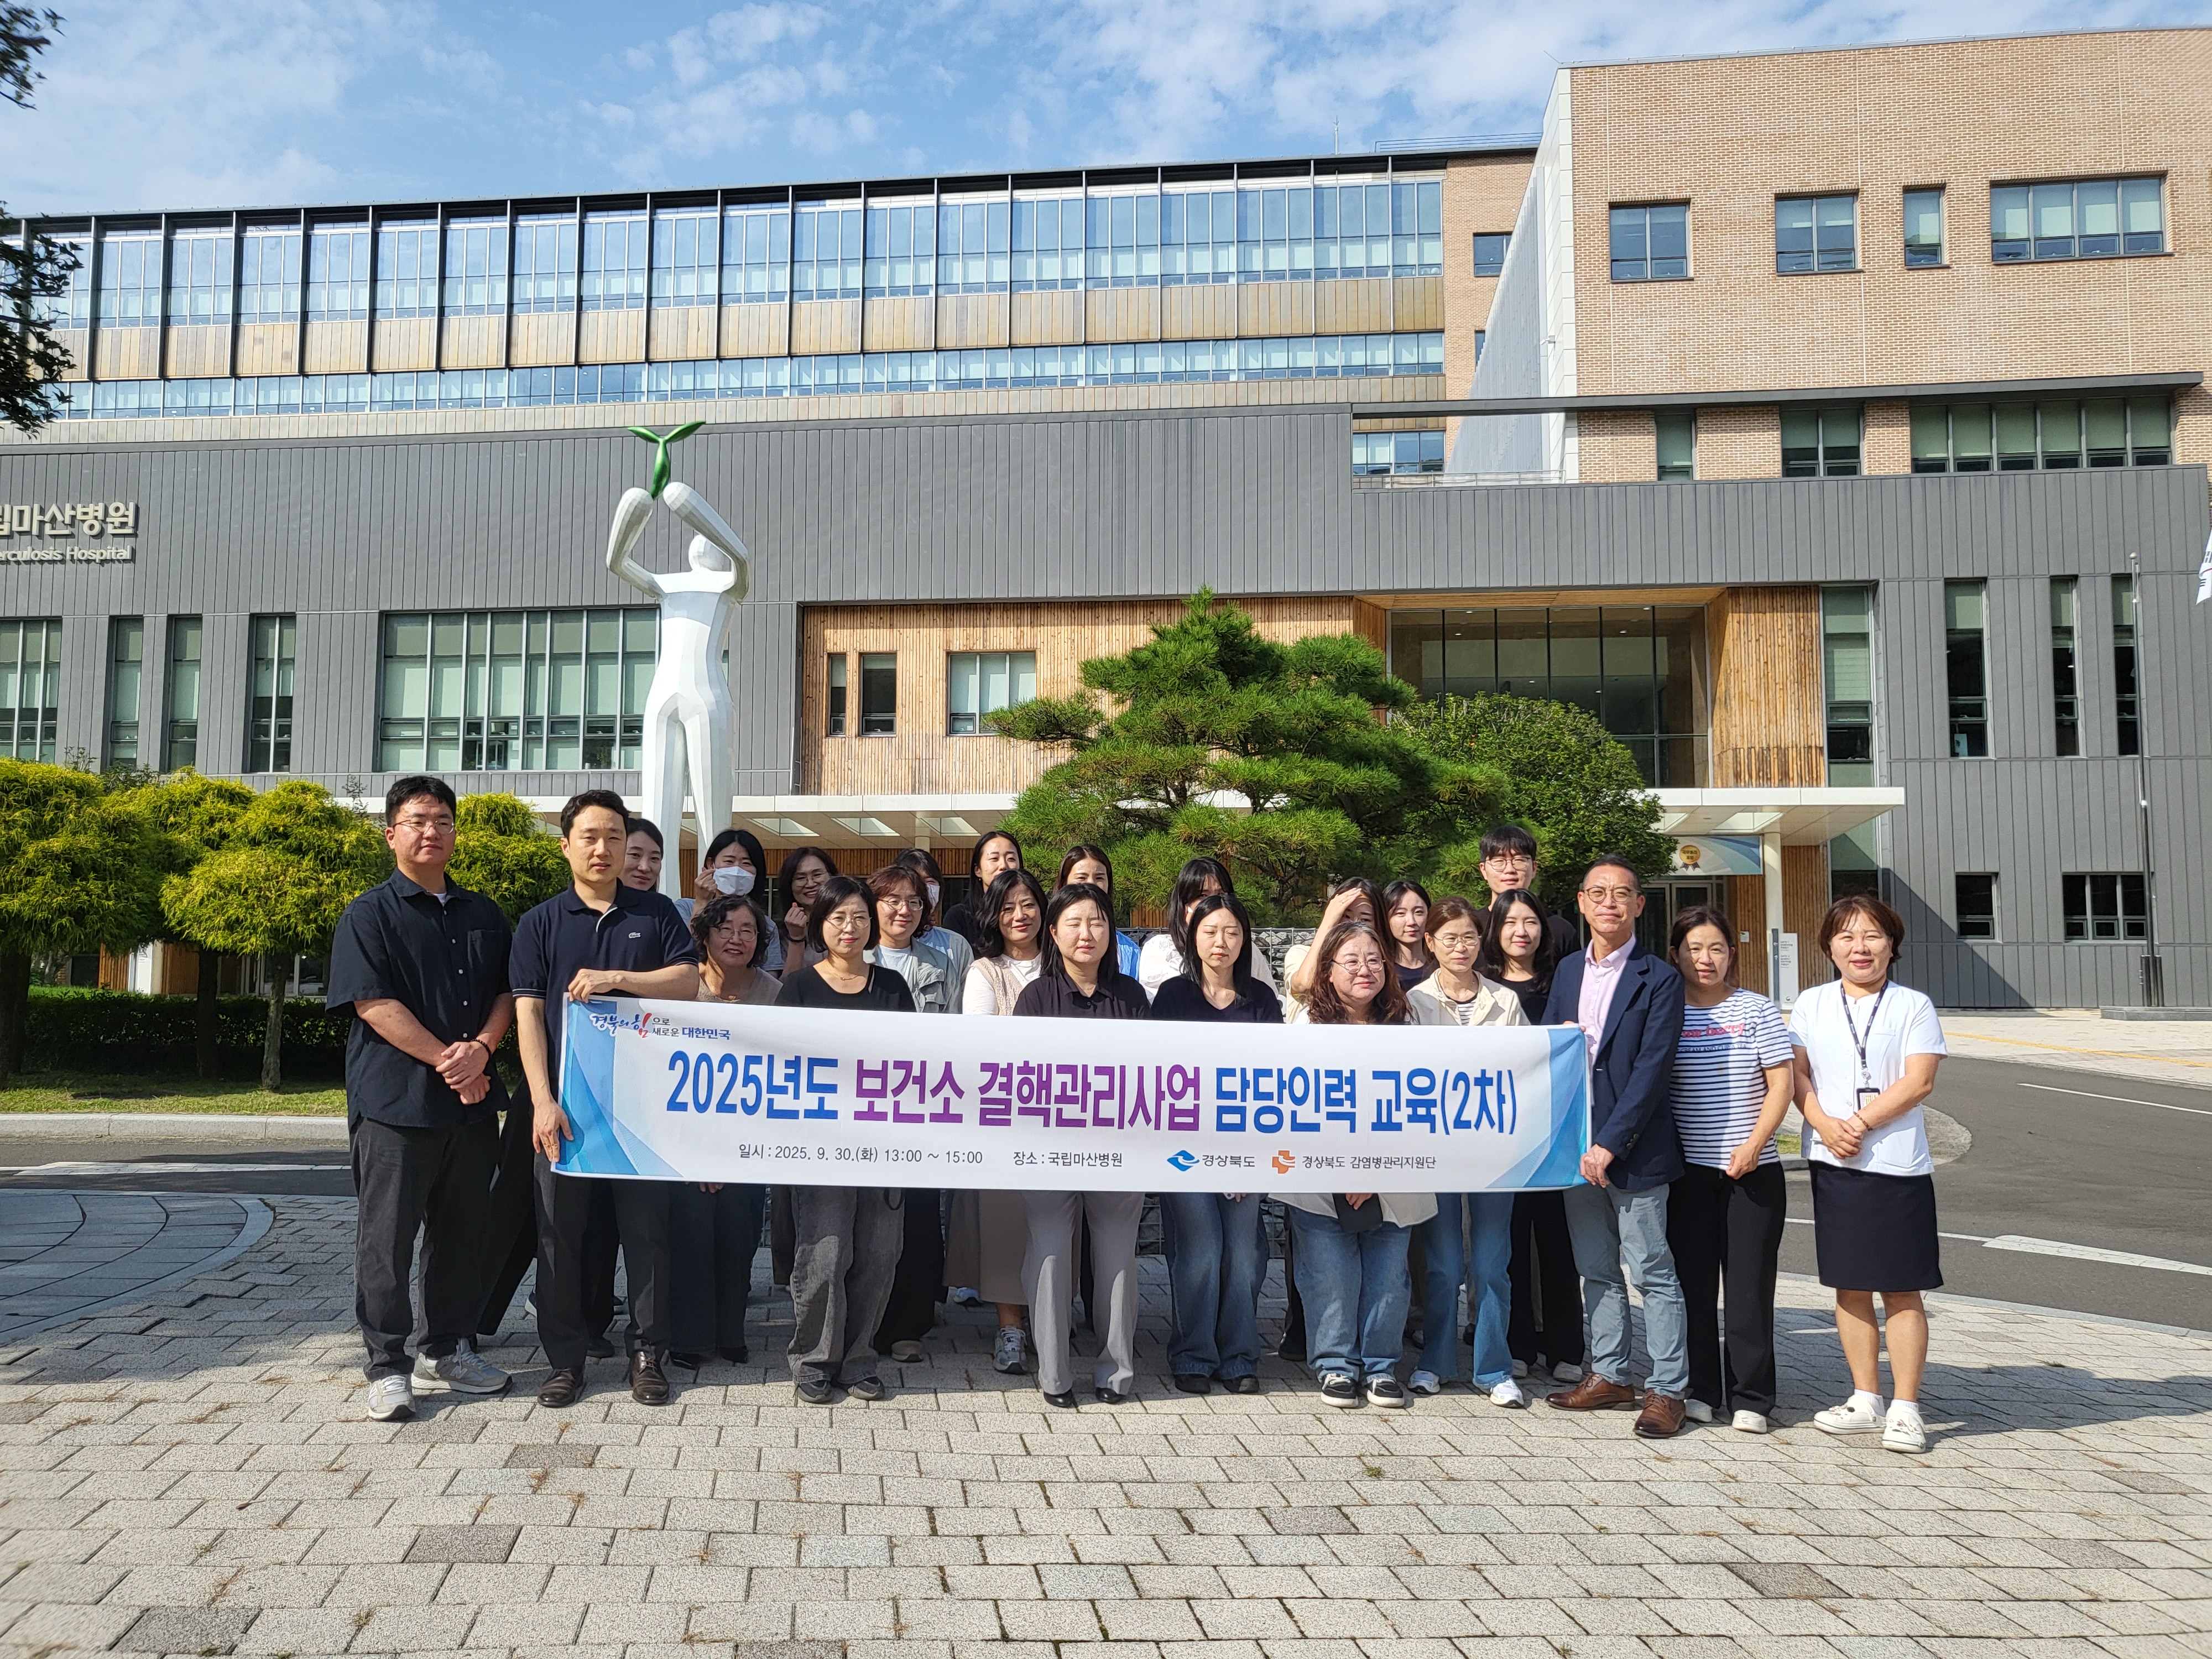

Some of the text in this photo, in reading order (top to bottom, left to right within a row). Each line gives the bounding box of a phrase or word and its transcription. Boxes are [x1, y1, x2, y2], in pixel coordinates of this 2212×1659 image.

[66, 545, 132, 563] Hospital
[652, 1027, 731, 1040] 새로운 대한민국
[666, 1050, 1517, 1136] 2025년도 보건소 결핵관리사업 담당인력 교육(2차)
[817, 1147, 828, 1161] 9.
[834, 1146, 878, 1163] 30.(화)
[885, 1149, 922, 1162] 13:00
[946, 1150, 983, 1164] 15:00
[1202, 1155, 1255, 1168] 경상북도
[1302, 1156, 1437, 1169] 경상북도 감염병관리지원단
